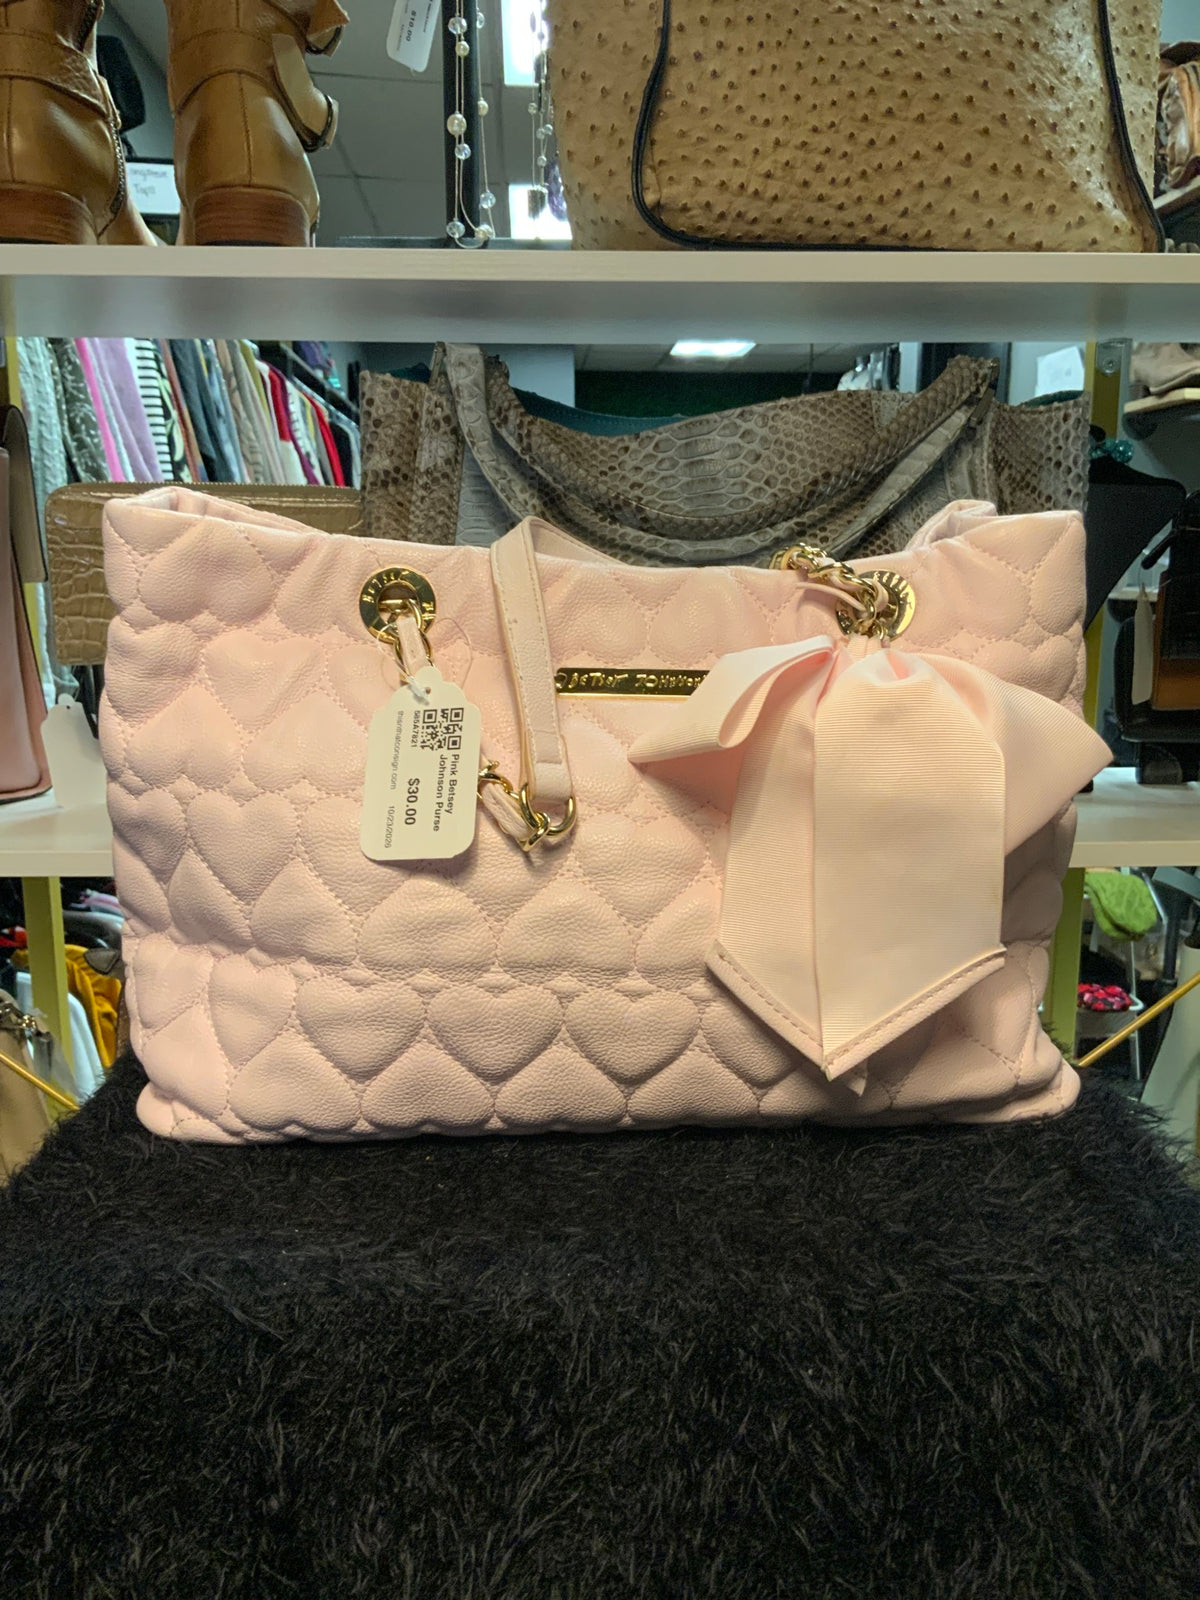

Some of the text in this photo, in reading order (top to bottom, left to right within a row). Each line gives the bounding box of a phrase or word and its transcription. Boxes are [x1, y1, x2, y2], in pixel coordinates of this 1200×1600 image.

[404, 777, 420, 826] $30.00
[433, 754, 448, 832] Johnson Purse
[444, 753, 460, 815] Pink Betsey
